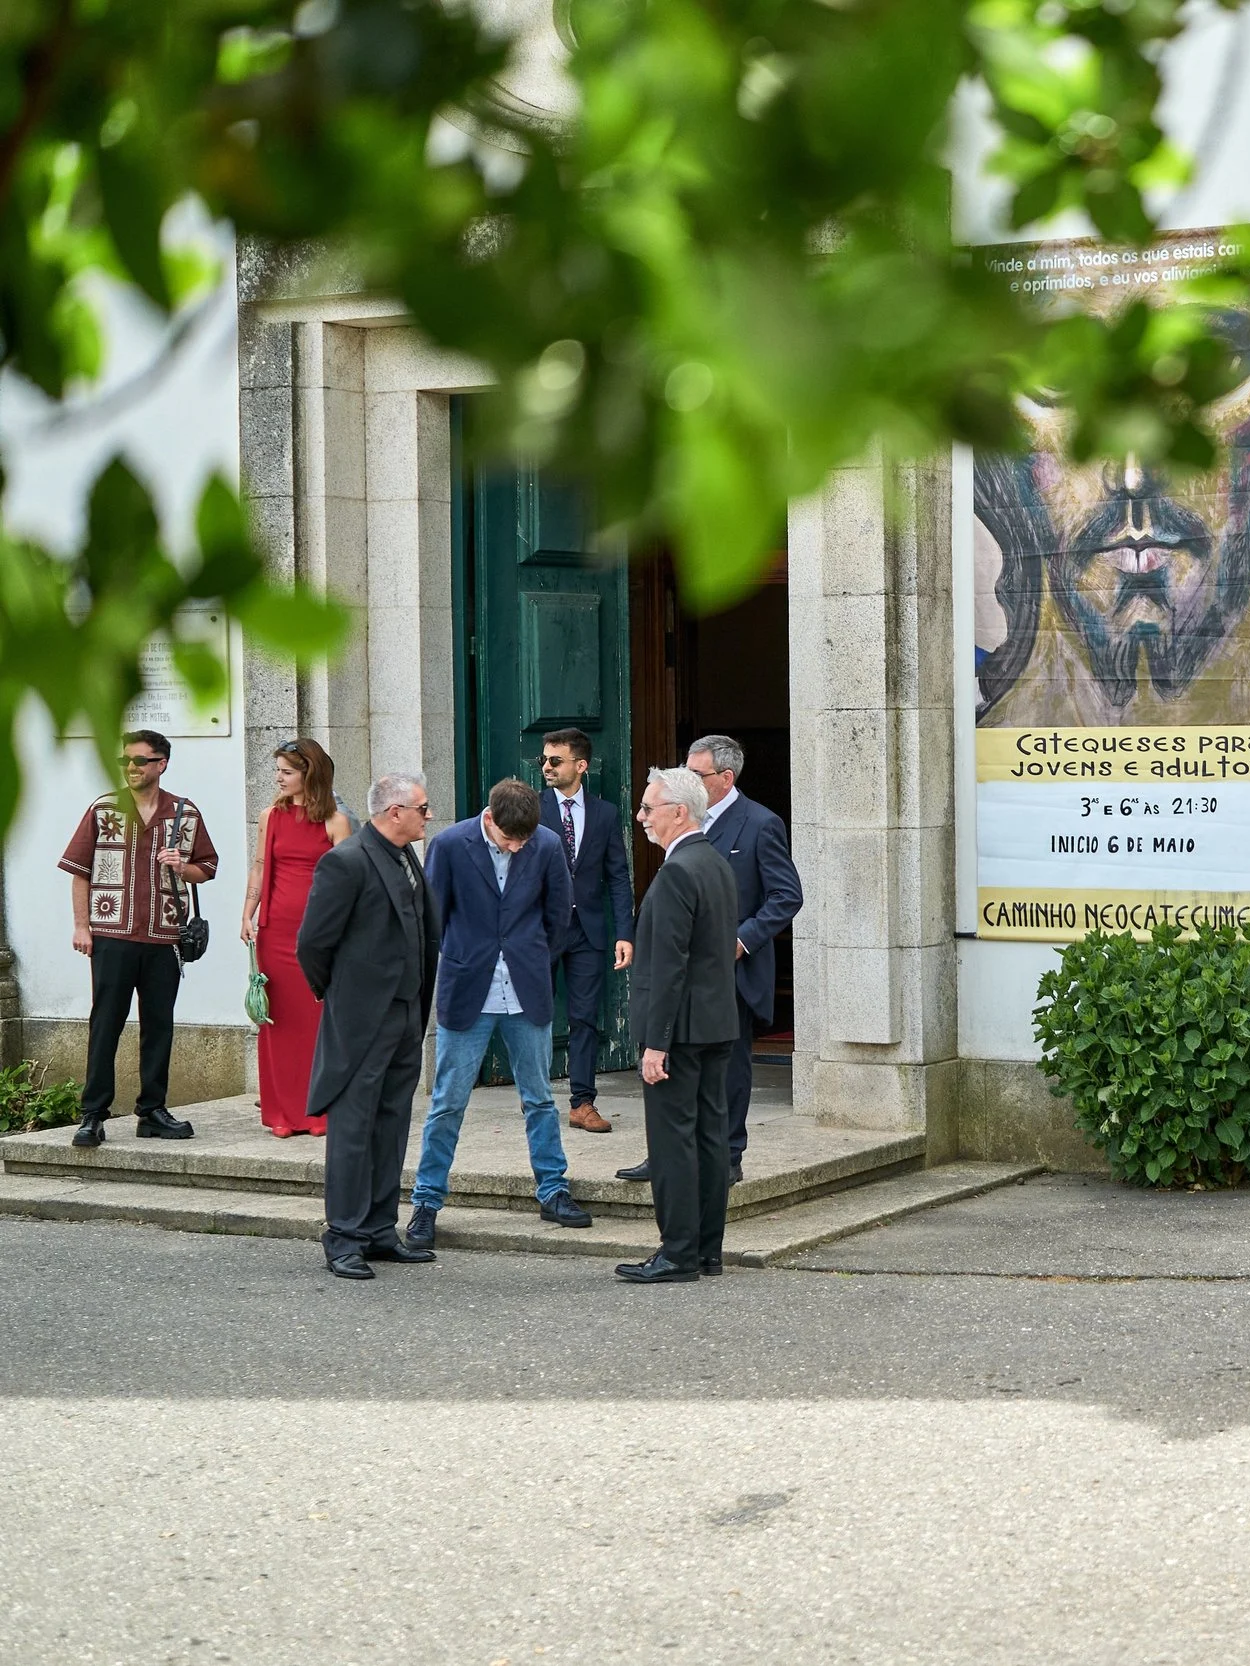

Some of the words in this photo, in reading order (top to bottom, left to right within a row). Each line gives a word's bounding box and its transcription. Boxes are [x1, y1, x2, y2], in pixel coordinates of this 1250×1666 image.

[1027, 259, 1036, 271] a
[1040, 254, 1075, 270] mim,
[1079, 250, 1119, 267] todos
[1122, 251, 1138, 264] os
[1142, 248, 1169, 265] que
[1173, 242, 1215, 260] estais
[1010, 281, 1019, 293] e
[1023, 273, 1096, 295] oprimidos,
[1099, 275, 1109, 286] e
[1112, 273, 1130, 286] eu
[1134, 271, 1158, 284] vos
[1016, 732, 1187, 756] Catequeses
[1103, 804, 1113, 816] E
[1143, 802, 1160, 815] ÀS
[1171, 797, 1218, 815] 21:30
[1051, 834, 1099, 854] INICIO
[1107, 835, 1119, 853] 6
[1127, 837, 1143, 853] DE
[1153, 837, 1195, 853] MAIO
[983, 901, 1076, 929] CAMINHO
